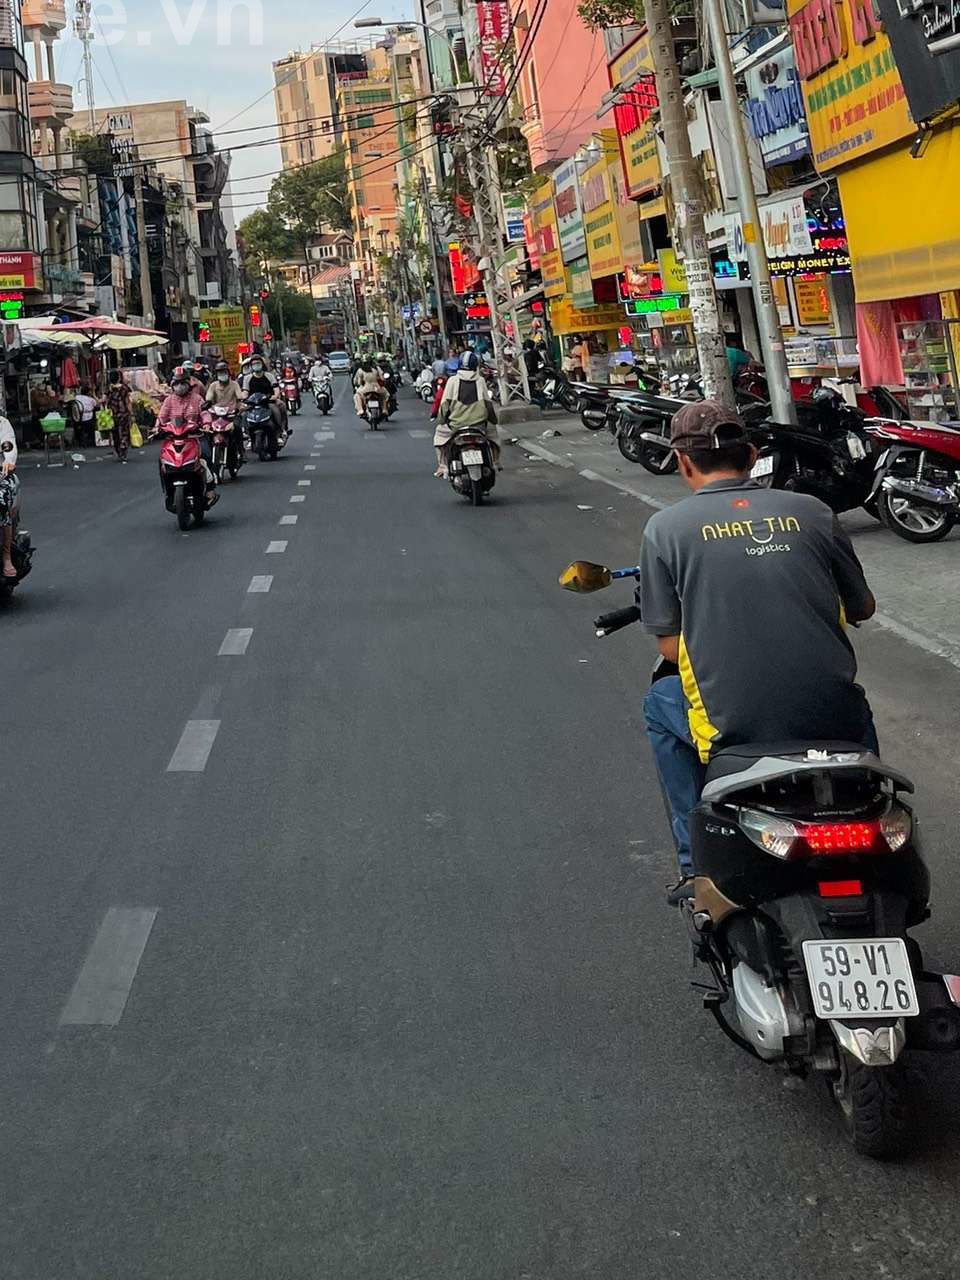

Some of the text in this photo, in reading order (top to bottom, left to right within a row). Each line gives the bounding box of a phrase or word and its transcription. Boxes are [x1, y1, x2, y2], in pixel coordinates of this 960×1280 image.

[767, 259, 795, 272] EIGN
[797, 256, 835, 270] MONEY
[763, 516, 801, 533] TIN
[745, 543, 791, 556] logistics
[820, 944, 892, 977] 59-V1
[818, 978, 911, 1013] 948.26
